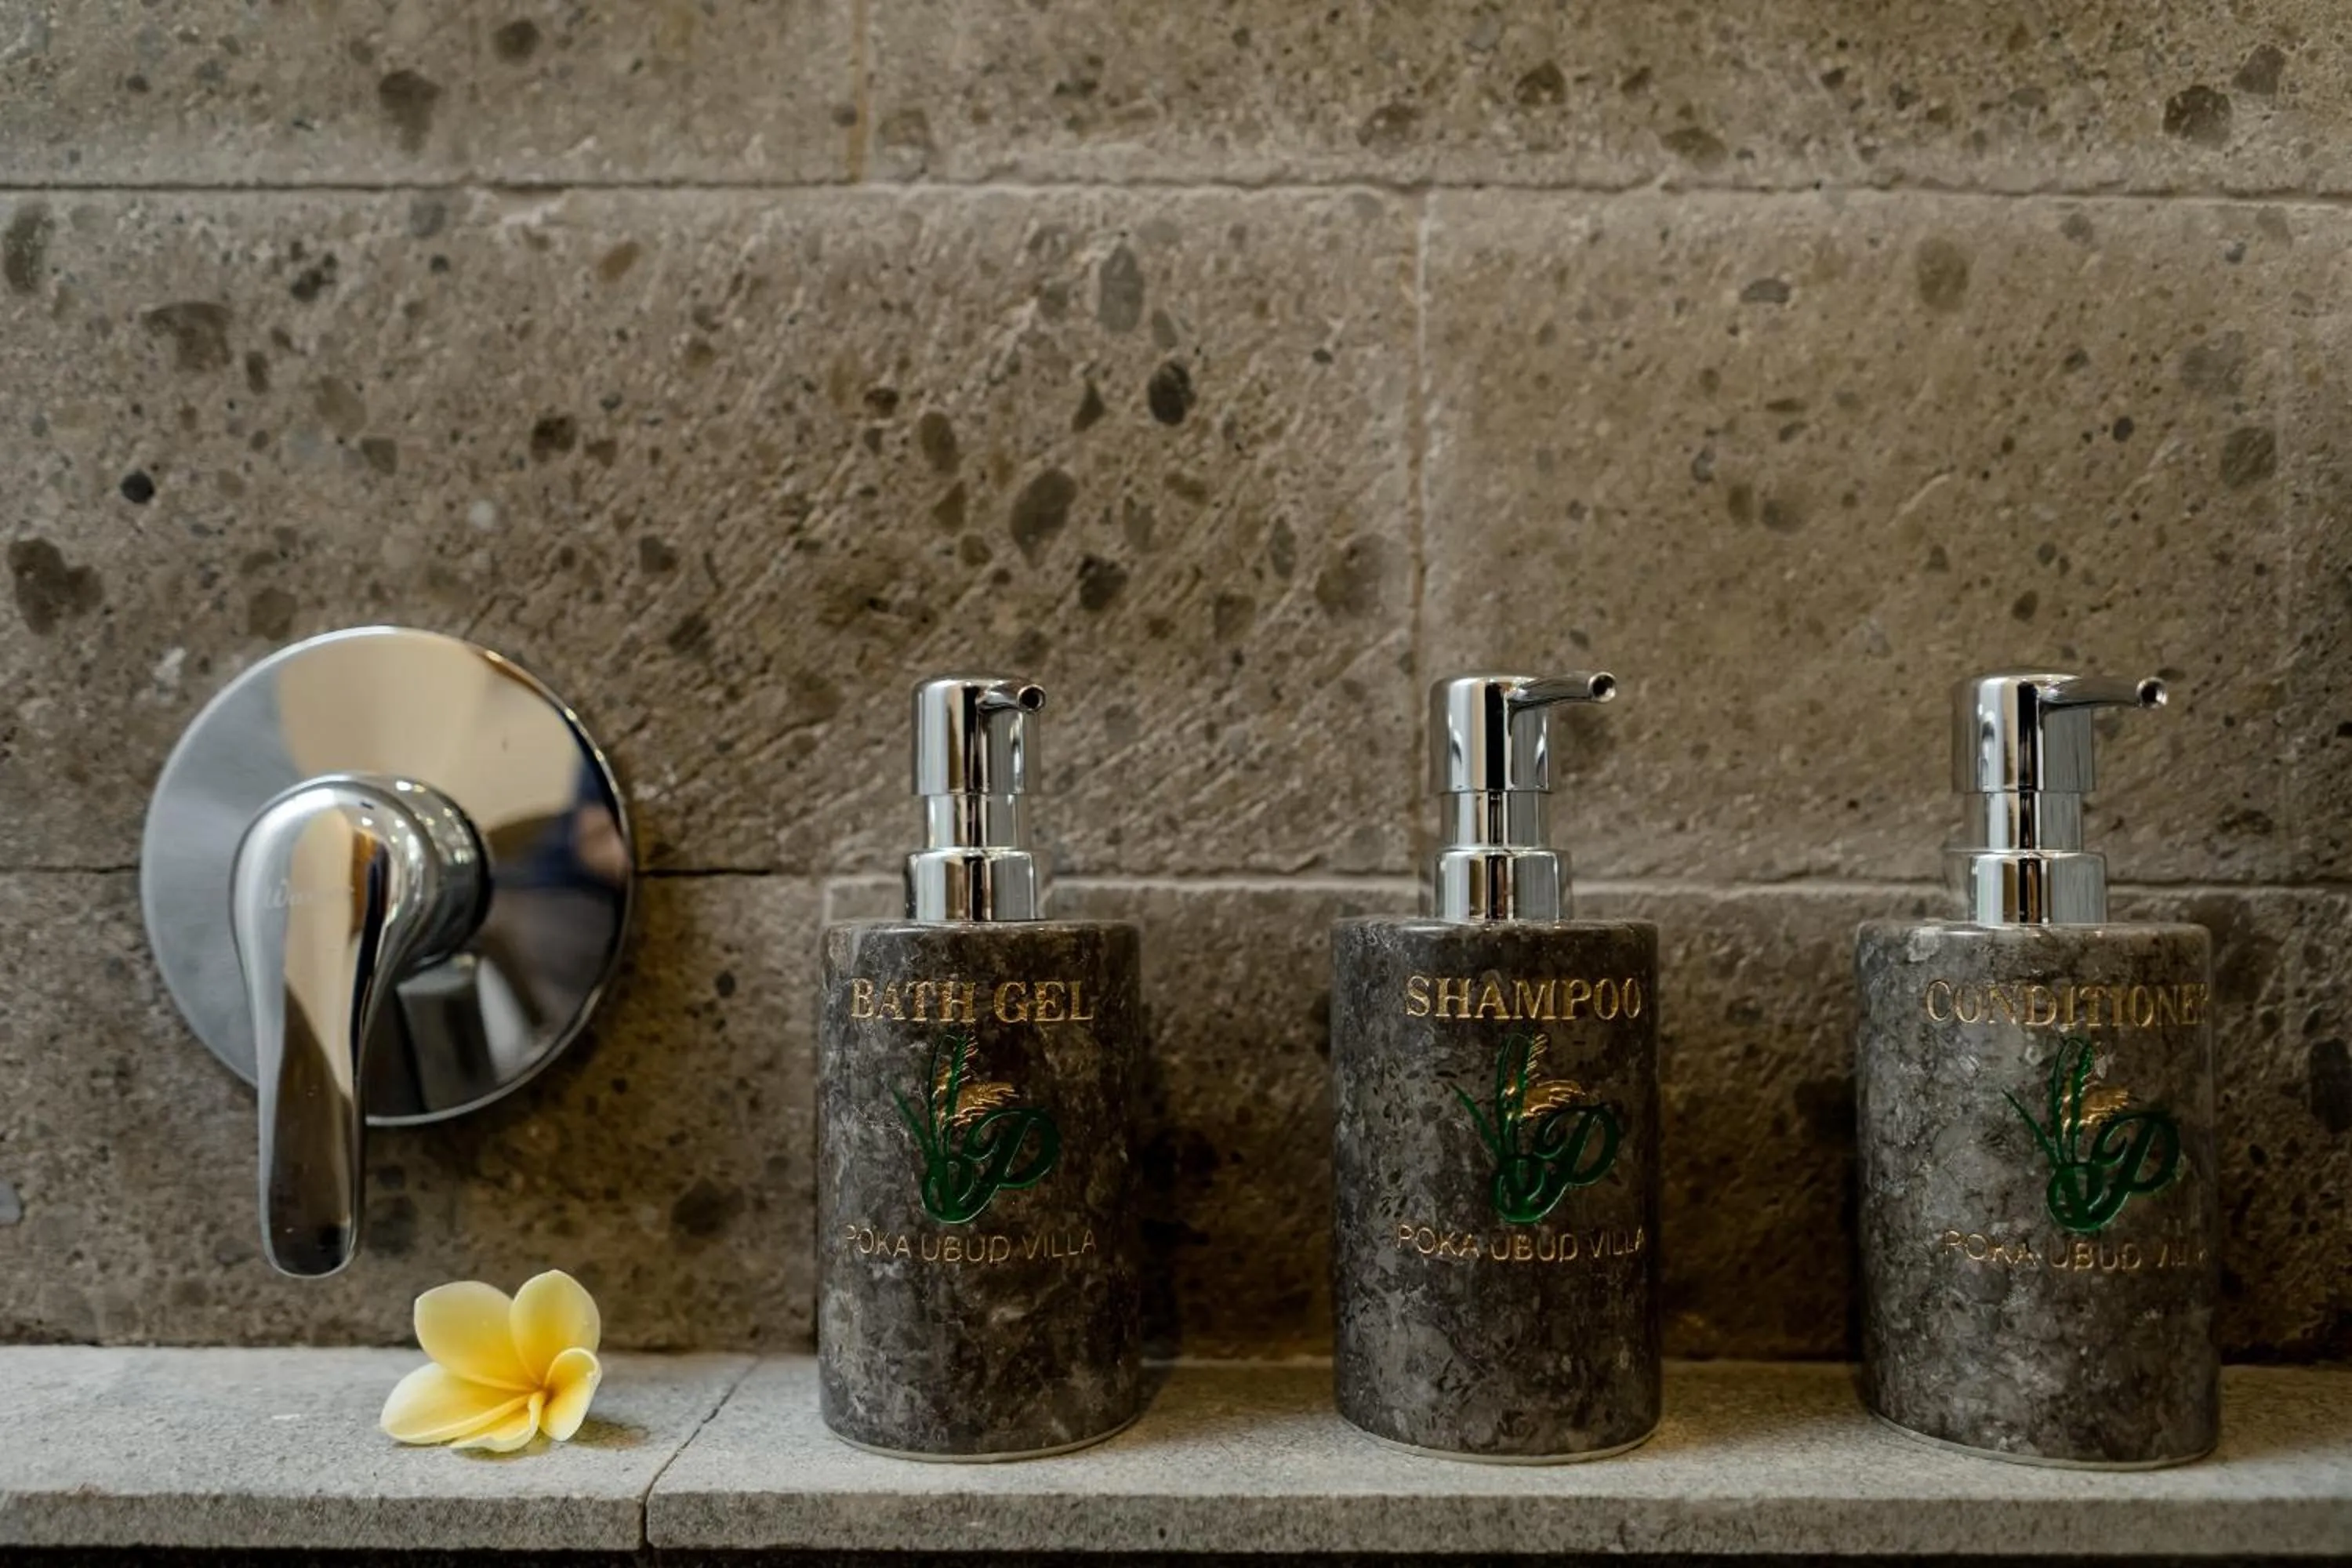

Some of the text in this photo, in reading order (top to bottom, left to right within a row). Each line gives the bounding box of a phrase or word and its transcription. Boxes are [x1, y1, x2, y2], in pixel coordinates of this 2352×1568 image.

[851, 978, 1094, 1023] BATH GEL
[1406, 975, 1642, 1020] SHAMPOO
[845, 1223, 1097, 1263] POKA UBUD VILLA
[1396, 1223, 1481, 1258] POKA
[1490, 1232, 1579, 1264] UBUD
[2049, 1240, 2143, 1272] UBUD
